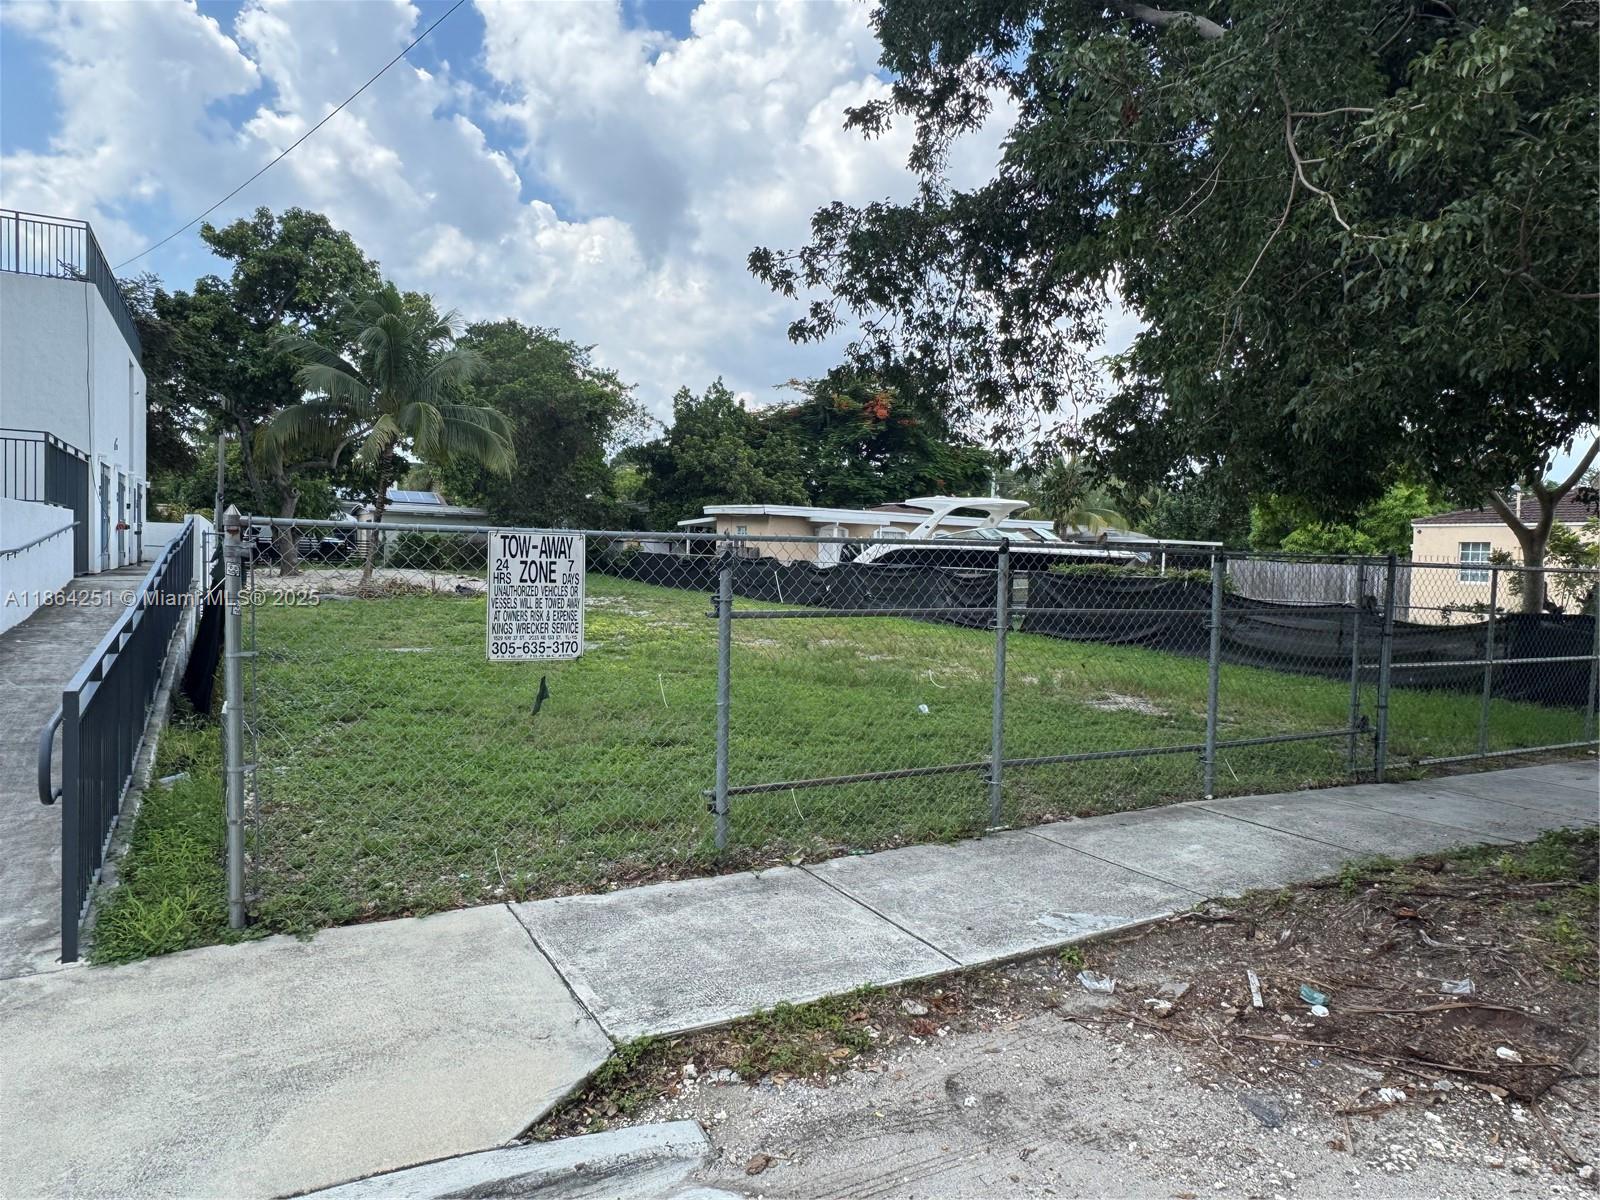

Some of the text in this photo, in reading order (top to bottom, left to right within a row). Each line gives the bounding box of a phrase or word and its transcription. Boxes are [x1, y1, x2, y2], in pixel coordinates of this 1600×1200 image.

[501, 535, 573, 559] TOW-AWAY
[496, 559, 509, 571] 24
[568, 560, 574, 572] 7
[520, 560, 556, 583] ZONE
[493, 572, 511, 584] HRS
[563, 573, 579, 584] DAYS
[494, 585, 578, 597] UNAUTHORIZED VEHICLES OR
[491, 598, 579, 609] VESSELS WILL BE TOWED AWAY
[494, 610, 577, 621] AT OWNERS RISK & EXPENSE
[492, 622, 578, 634] KINGS WRECKER SERVICE
[492, 641, 578, 654] 305-635-3170
